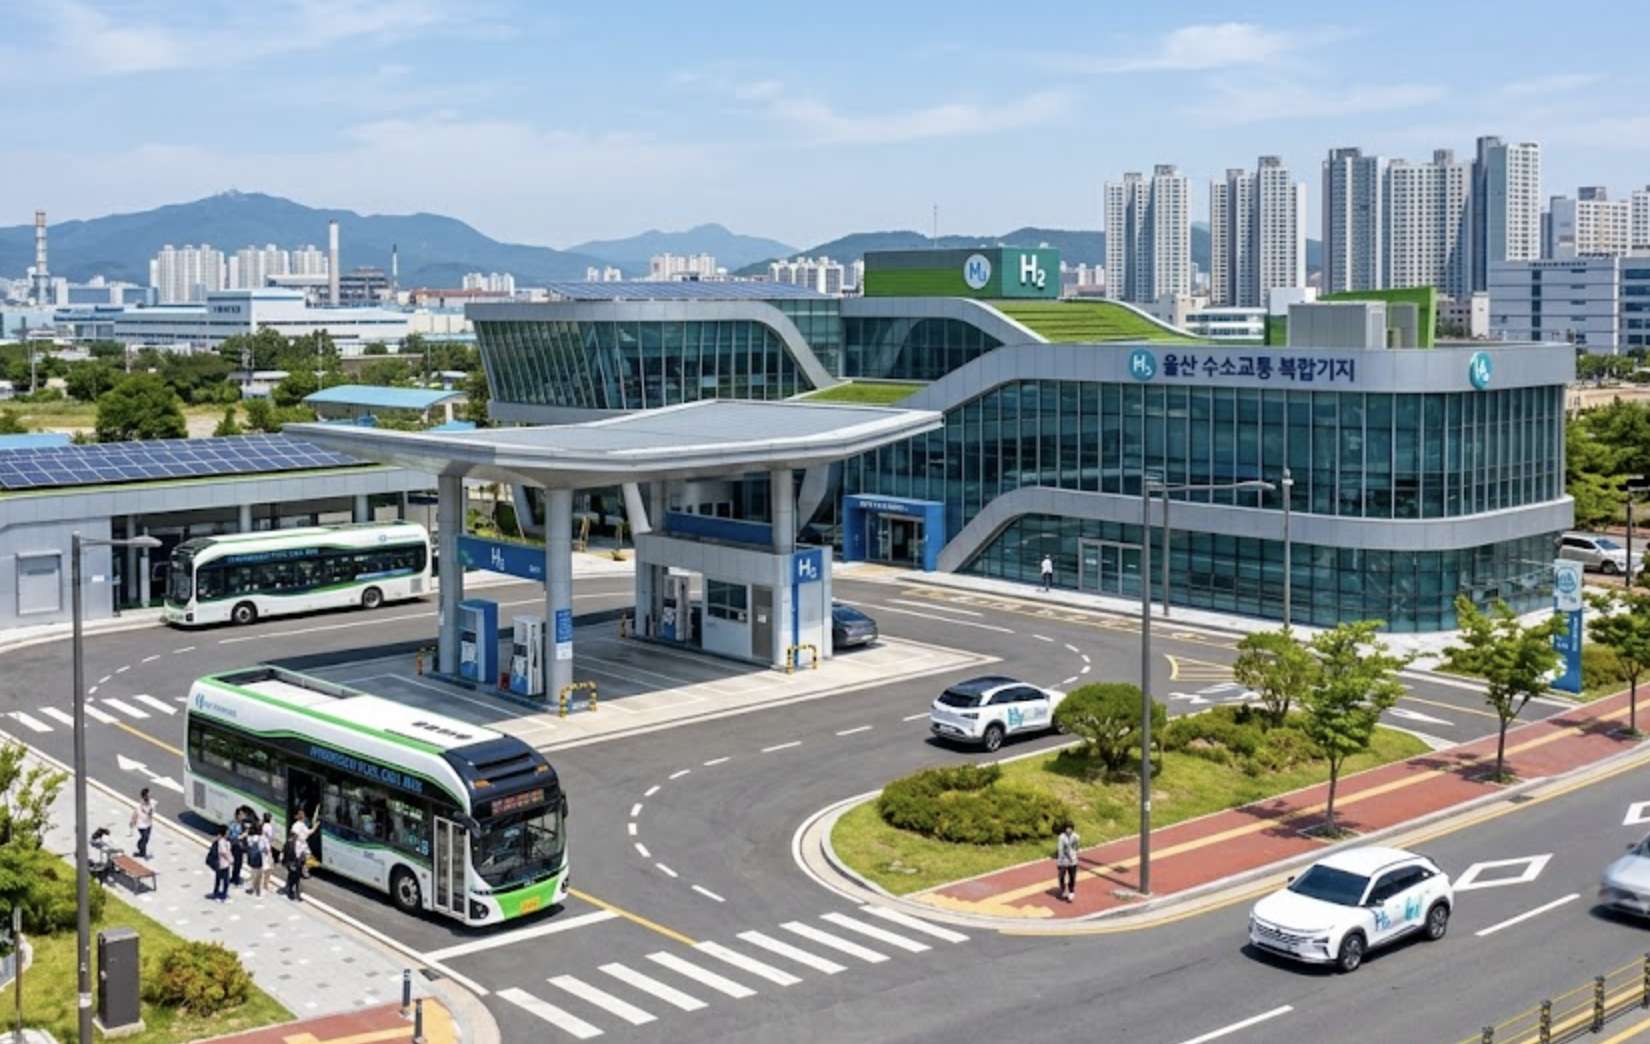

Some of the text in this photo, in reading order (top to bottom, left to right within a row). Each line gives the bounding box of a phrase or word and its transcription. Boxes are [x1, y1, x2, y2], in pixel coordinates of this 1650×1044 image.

[1020, 254, 1046, 287] H2
[1163, 354, 1354, 382] 울산 수소교통 복합기지
